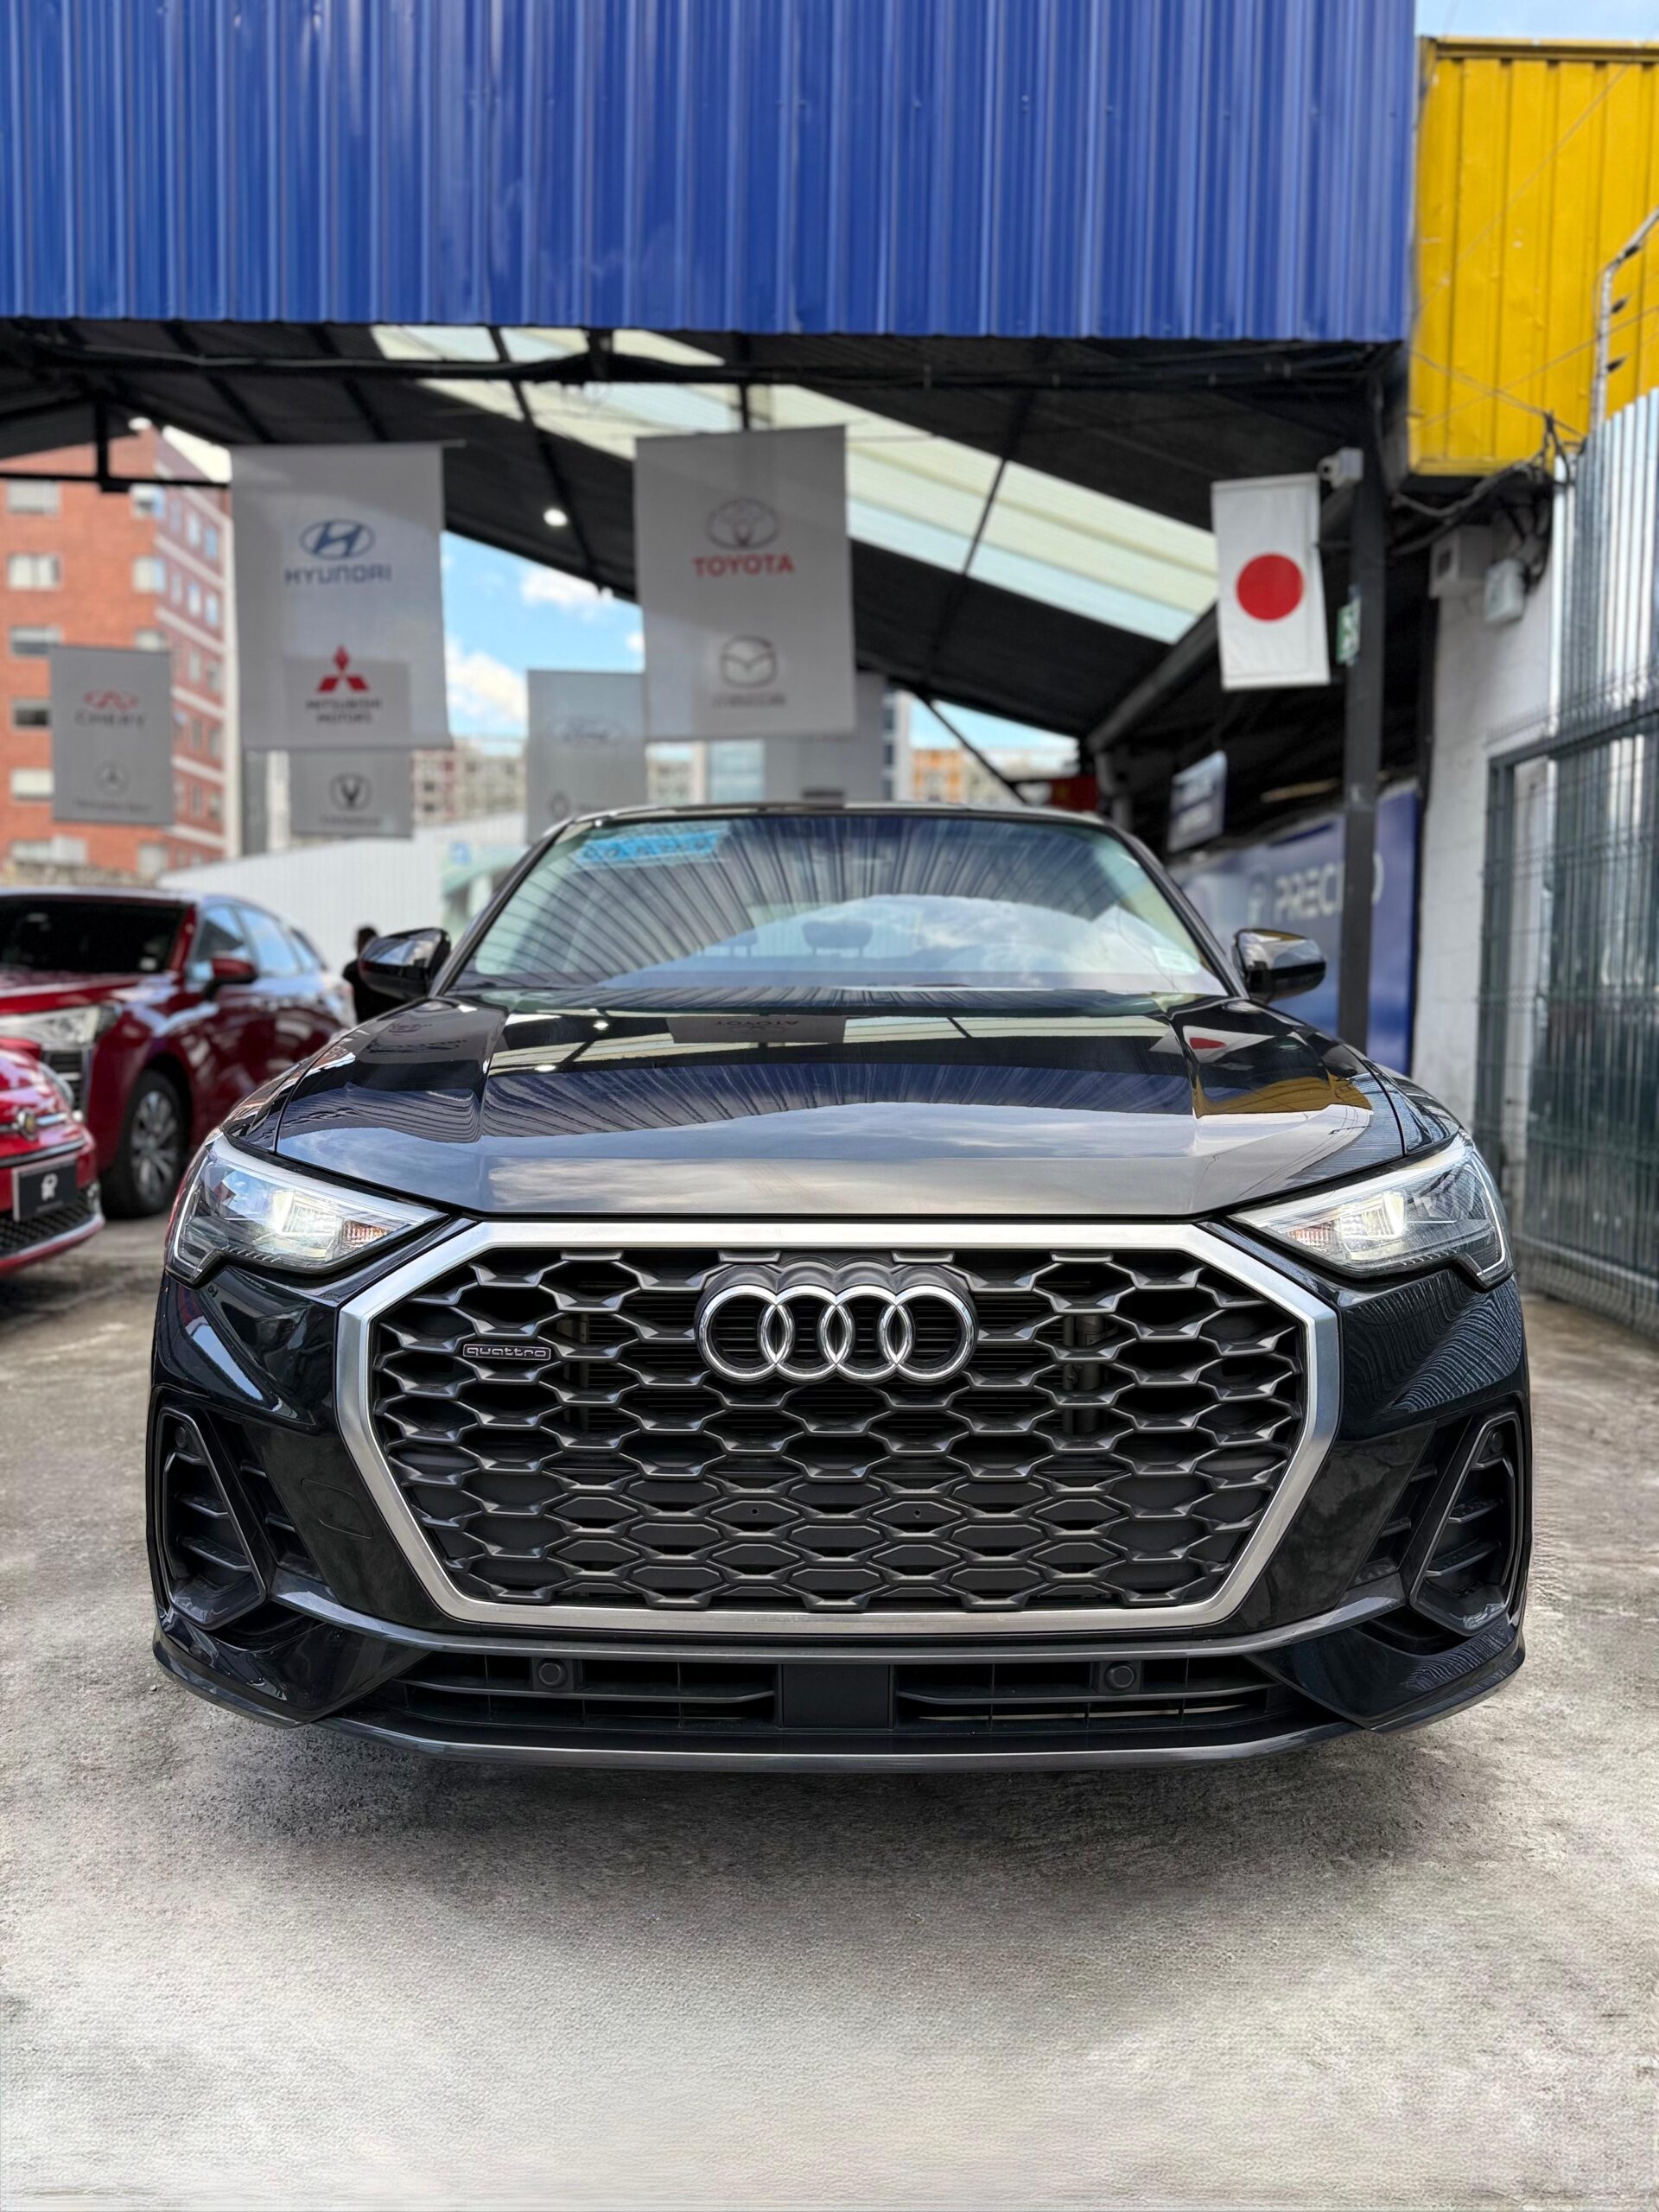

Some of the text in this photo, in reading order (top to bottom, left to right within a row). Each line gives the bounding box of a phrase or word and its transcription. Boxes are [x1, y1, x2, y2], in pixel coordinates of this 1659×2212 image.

[284, 563, 391, 585] HYUNDAI
[691, 552, 796, 578] TOYOTA
[1273, 850, 1384, 925] PRECI
[467, 1347, 547, 1357] quattro
